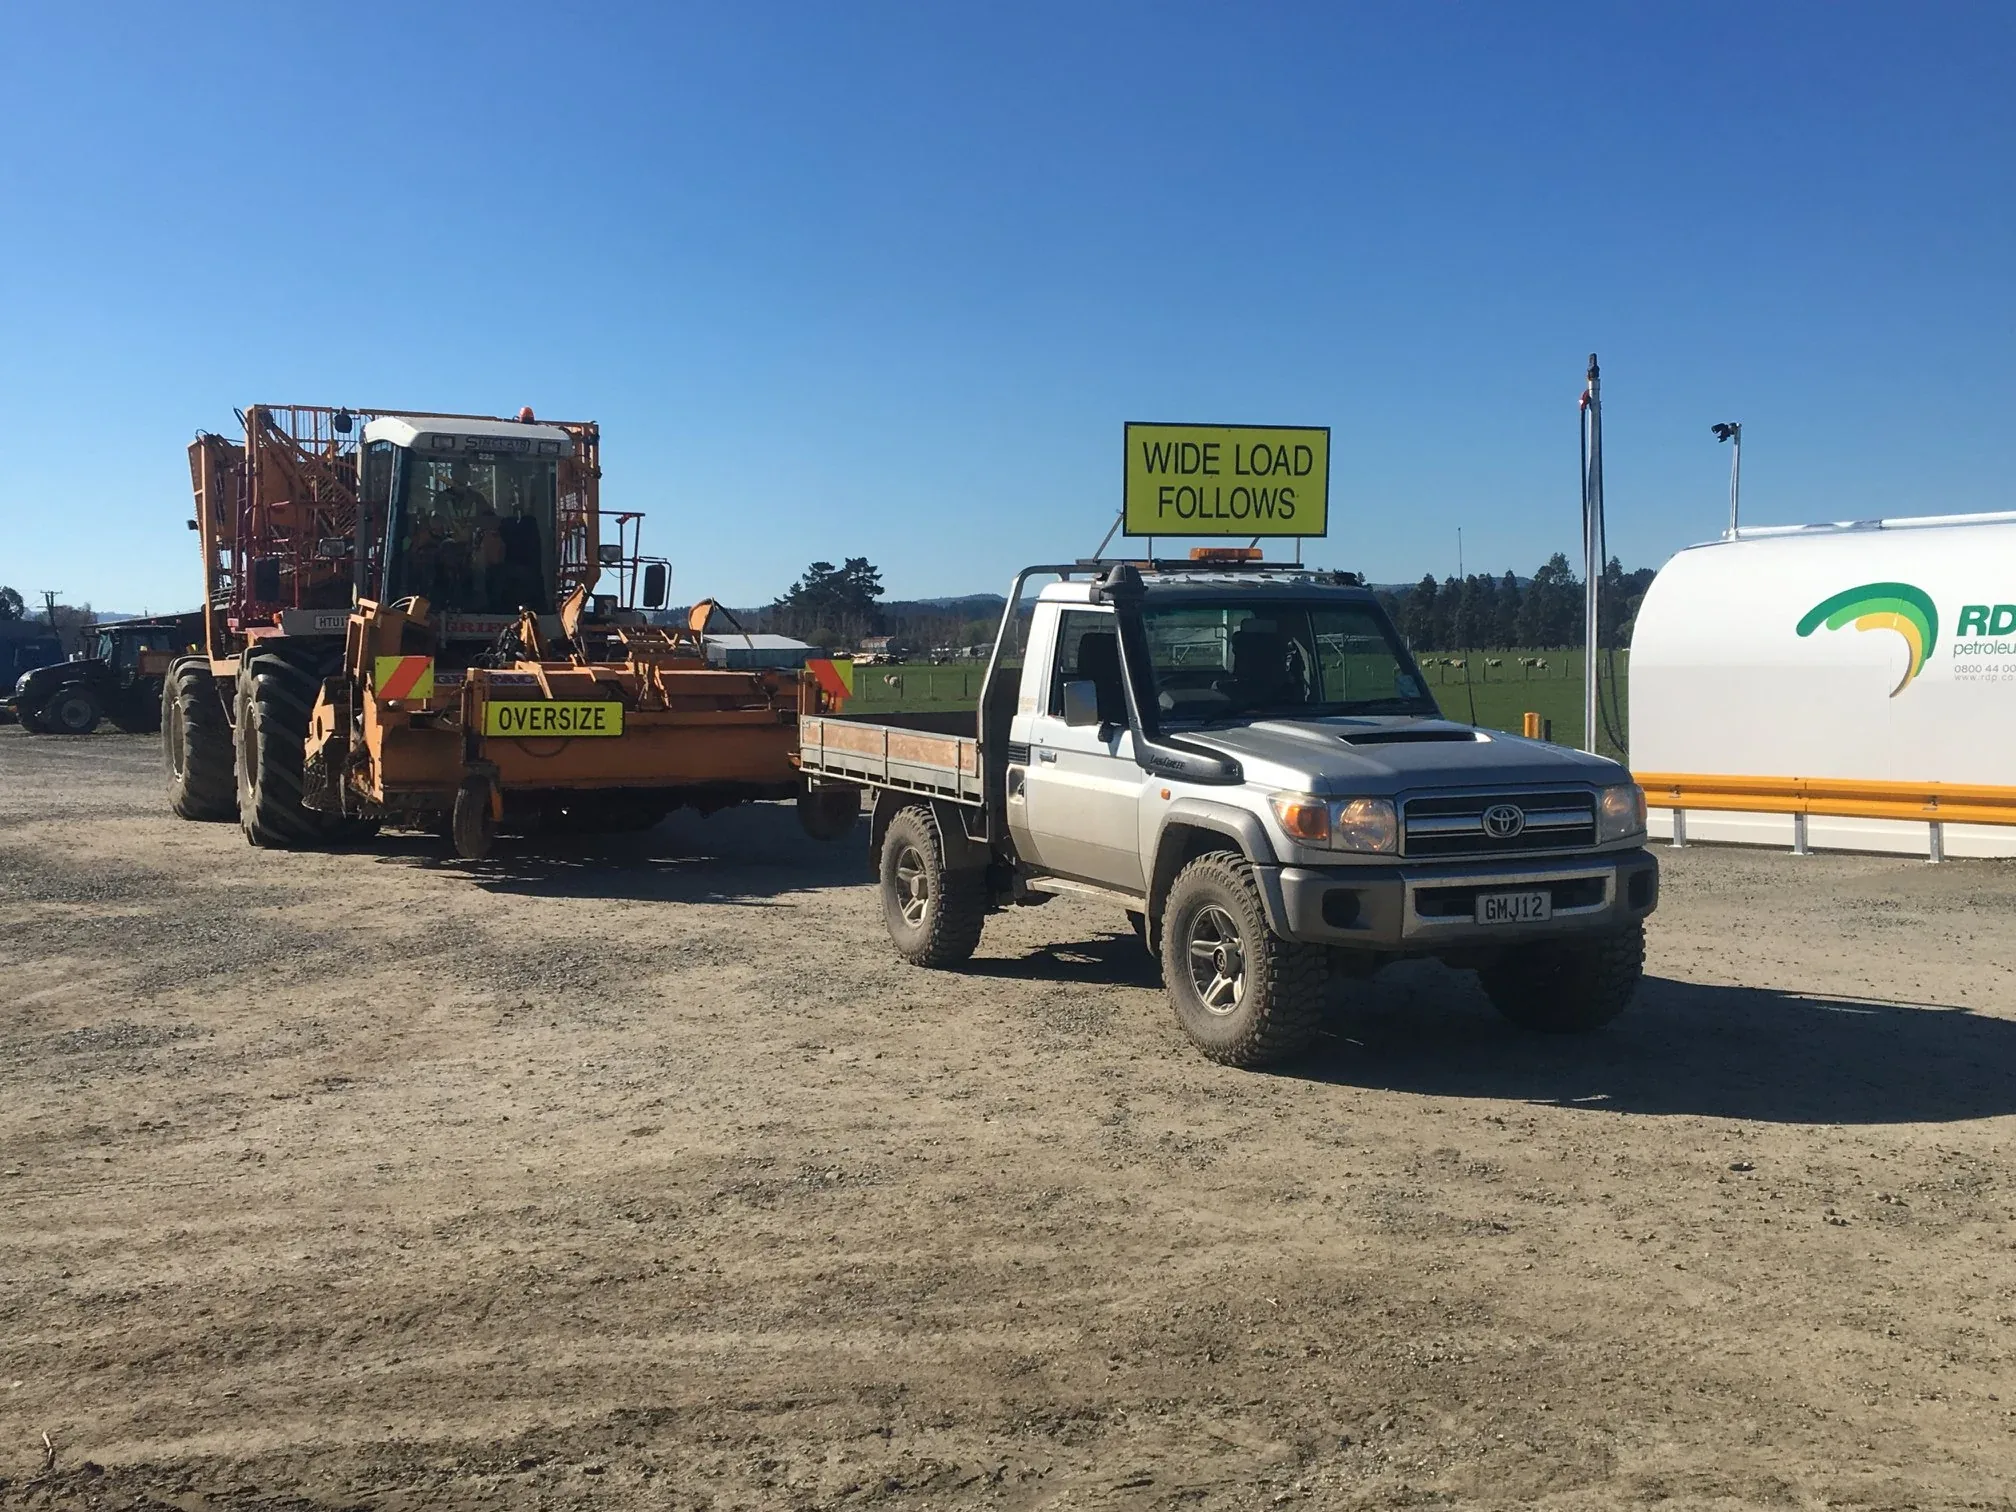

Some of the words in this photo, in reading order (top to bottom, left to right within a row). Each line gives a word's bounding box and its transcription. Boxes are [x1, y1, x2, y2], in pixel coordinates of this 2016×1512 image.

[1142, 442, 1220, 475] WIDE
[1235, 443, 1313, 476] LOAD
[1158, 486, 1296, 519] FOLLOWS
[1954, 664, 1982, 673] 0800
[1985, 664, 1999, 673] 44
[499, 707, 606, 730] OVERSIZE
[1486, 896, 1543, 919] GMJ12
